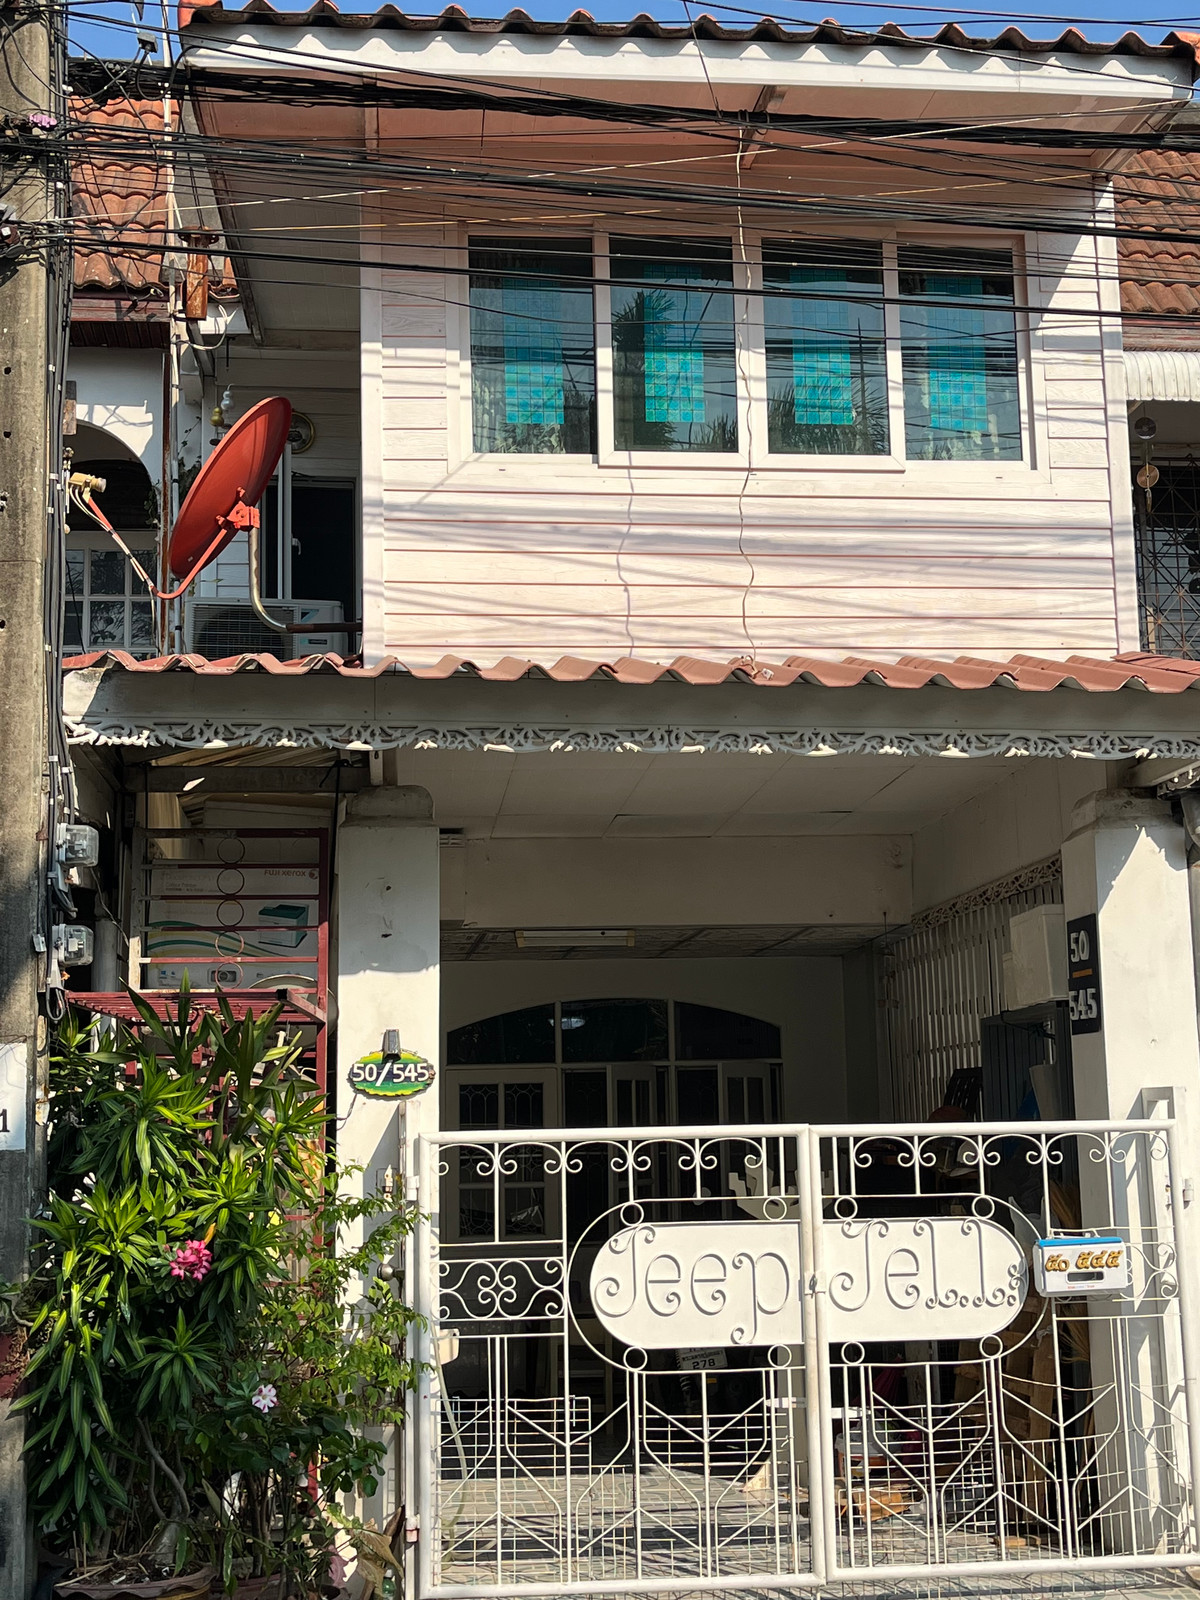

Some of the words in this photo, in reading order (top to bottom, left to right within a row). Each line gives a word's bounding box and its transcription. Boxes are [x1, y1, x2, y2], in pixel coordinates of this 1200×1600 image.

[1070, 930, 1090, 963] 50
[1068, 988, 1098, 1020] 545
[352, 1062, 429, 1087] 50/545
[593, 1224, 790, 1345] Jeep
[692, 1358, 715, 1369] 278
